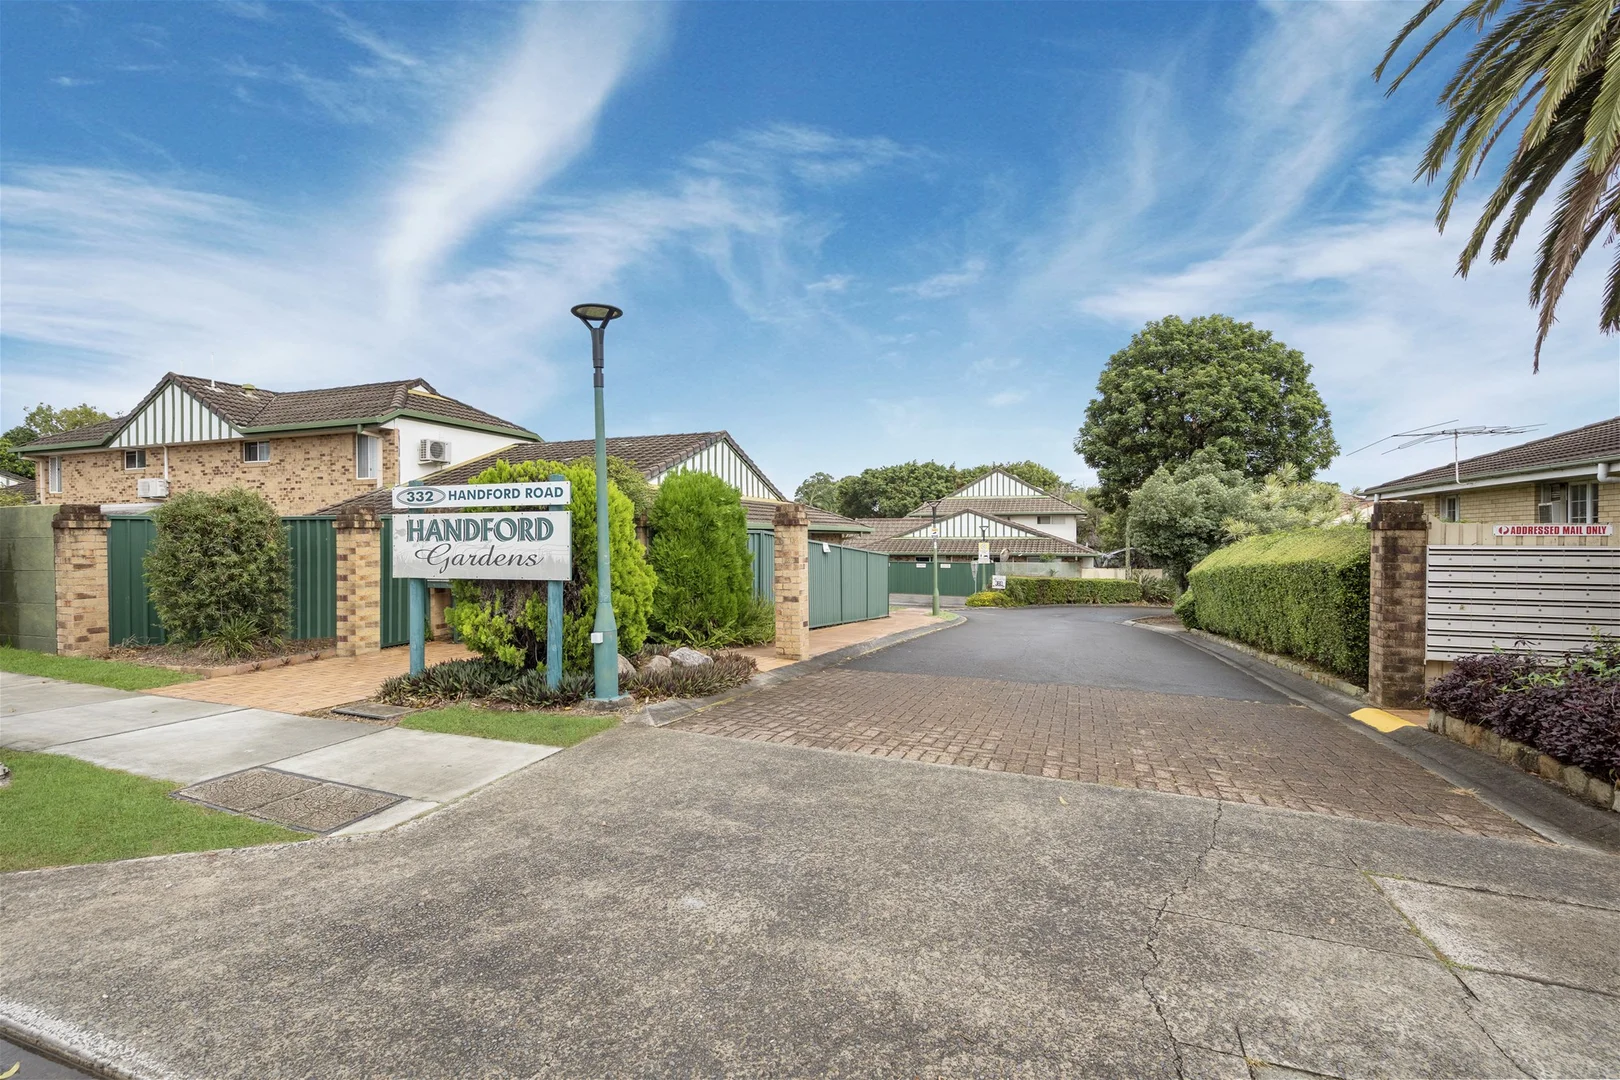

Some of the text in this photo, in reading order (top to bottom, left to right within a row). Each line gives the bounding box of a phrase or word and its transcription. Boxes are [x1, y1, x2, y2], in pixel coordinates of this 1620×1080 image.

[406, 486, 564, 503] 332 HANDFORD ROAD
[406, 517, 554, 543] HANDFORD
[1510, 526, 1607, 534] ADDRESSED MAIL ONLY
[414, 543, 545, 574] Gardens
